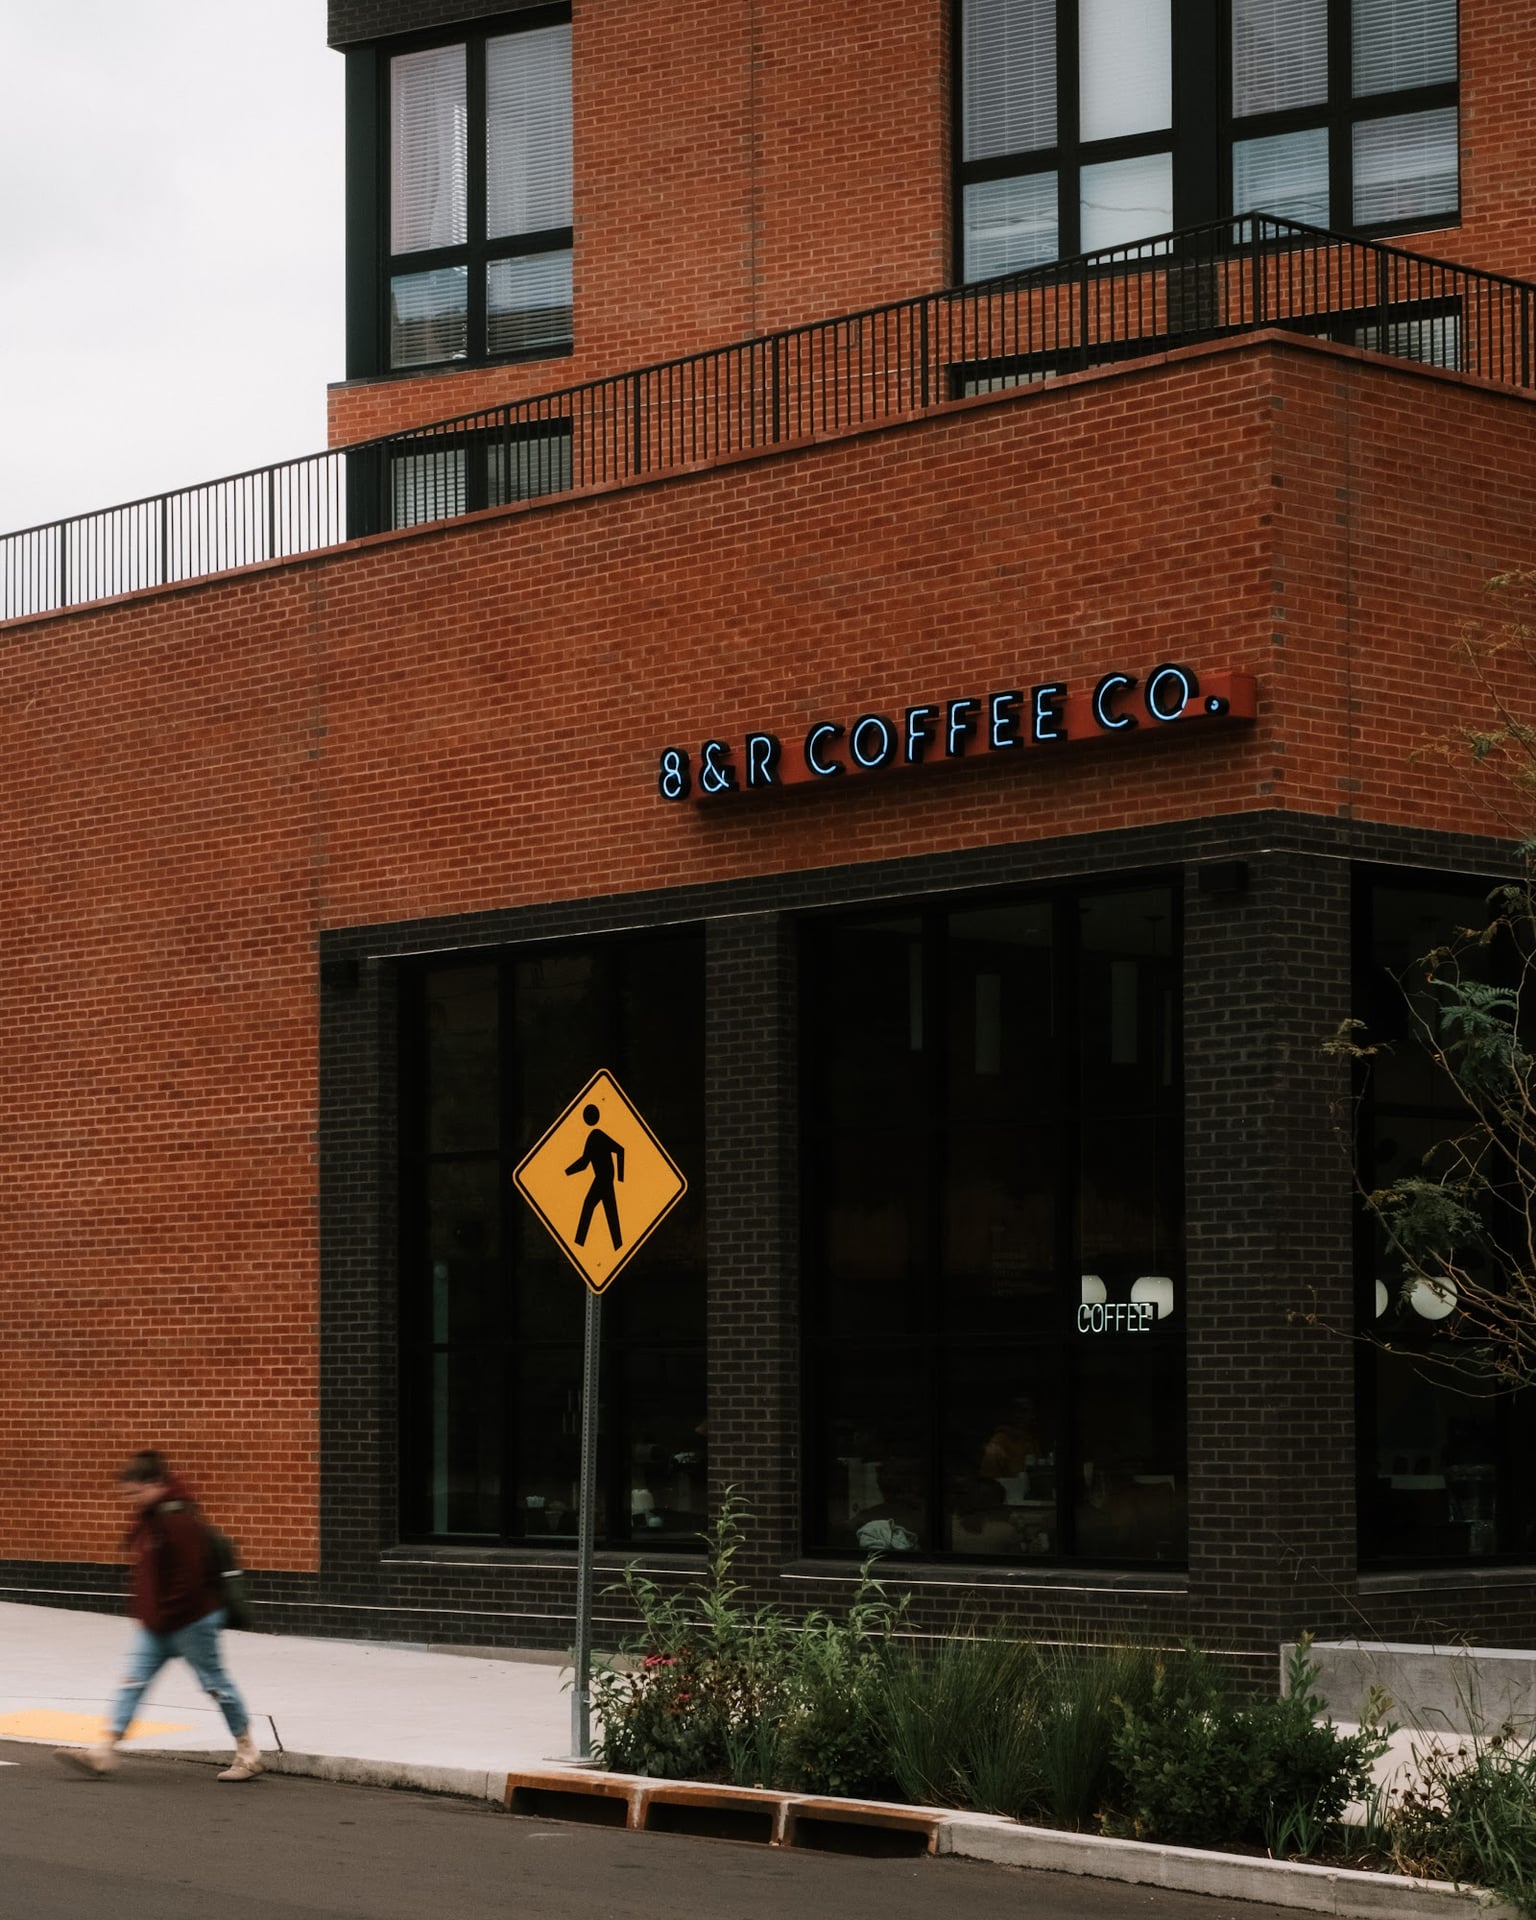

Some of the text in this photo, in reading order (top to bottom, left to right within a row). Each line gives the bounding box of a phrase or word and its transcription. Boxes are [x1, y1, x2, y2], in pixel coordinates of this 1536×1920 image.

[805, 682, 1068, 777] COFFEE
[1092, 662, 1229, 731] CO.
[1077, 1303, 1150, 1333] COFFEE
